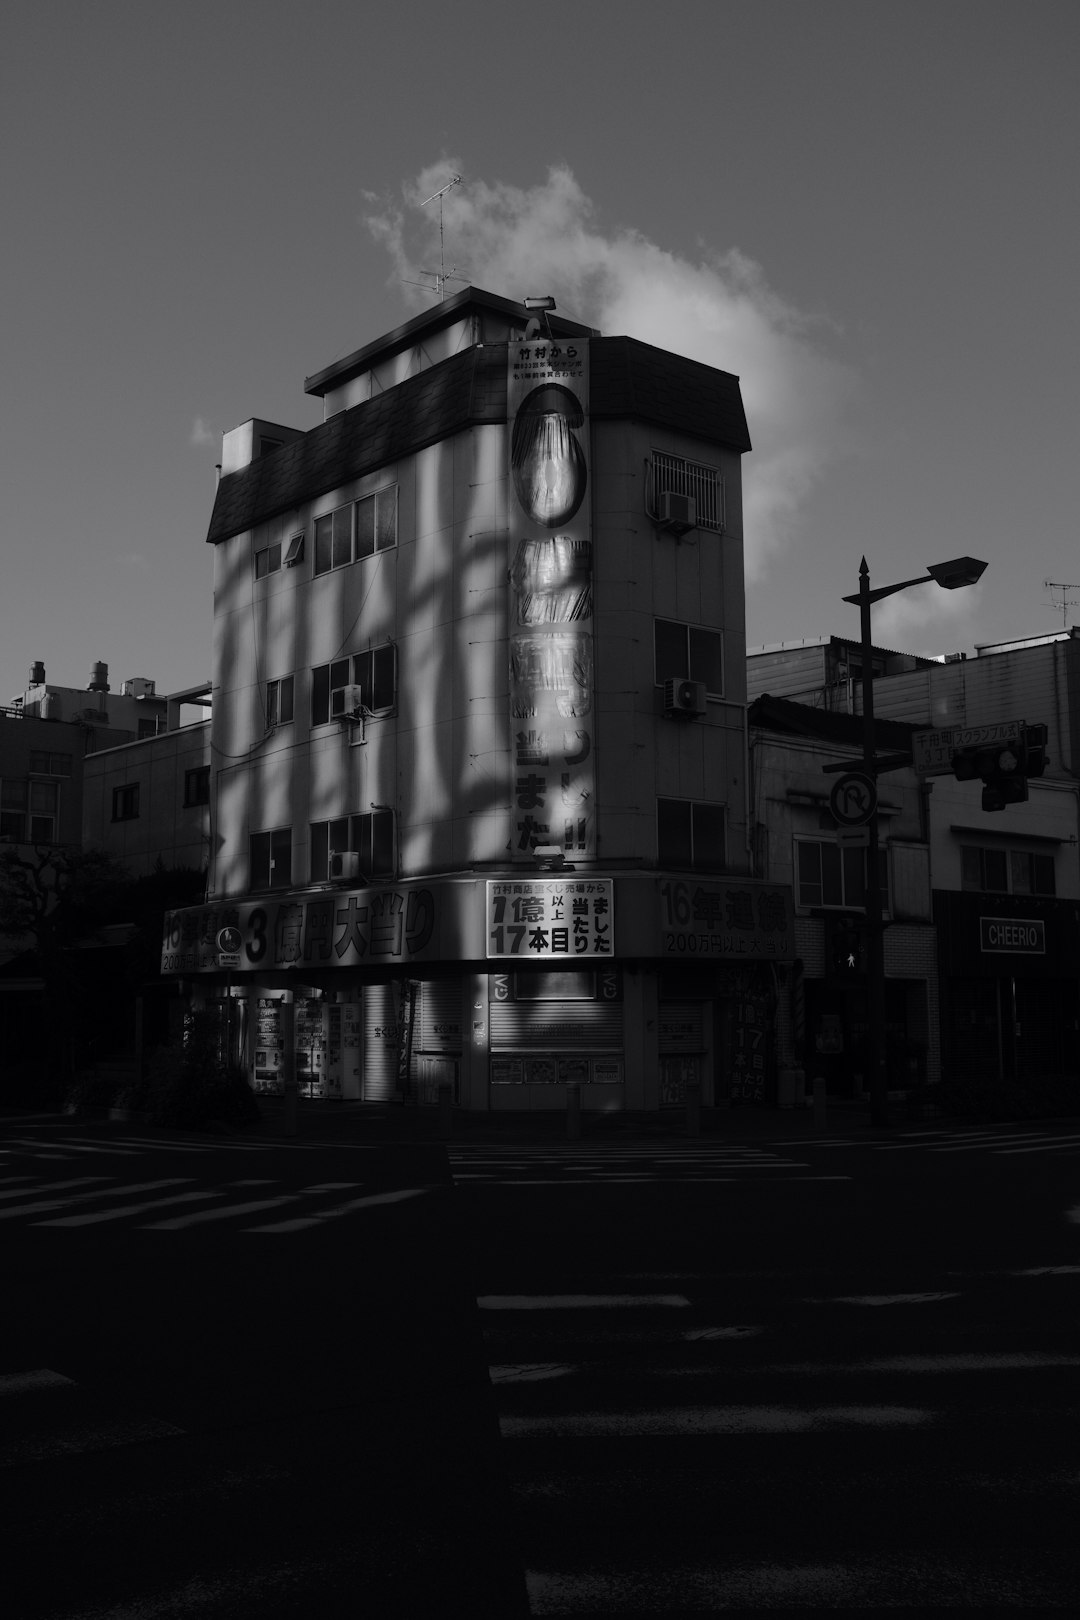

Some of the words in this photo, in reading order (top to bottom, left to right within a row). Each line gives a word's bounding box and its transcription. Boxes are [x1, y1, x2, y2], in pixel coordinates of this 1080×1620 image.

[519, 346, 577, 360] 竹村から
[956, 724, 1017, 745] スクランブル式
[493, 883, 606, 895] 竹村商店宝くじ売場から
[662, 882, 787, 932] 16年連続
[491, 925, 569, 954] 17本目
[666, 933, 790, 954] 200万円以上大当り
[988, 924, 1038, 947] CHEERIO
